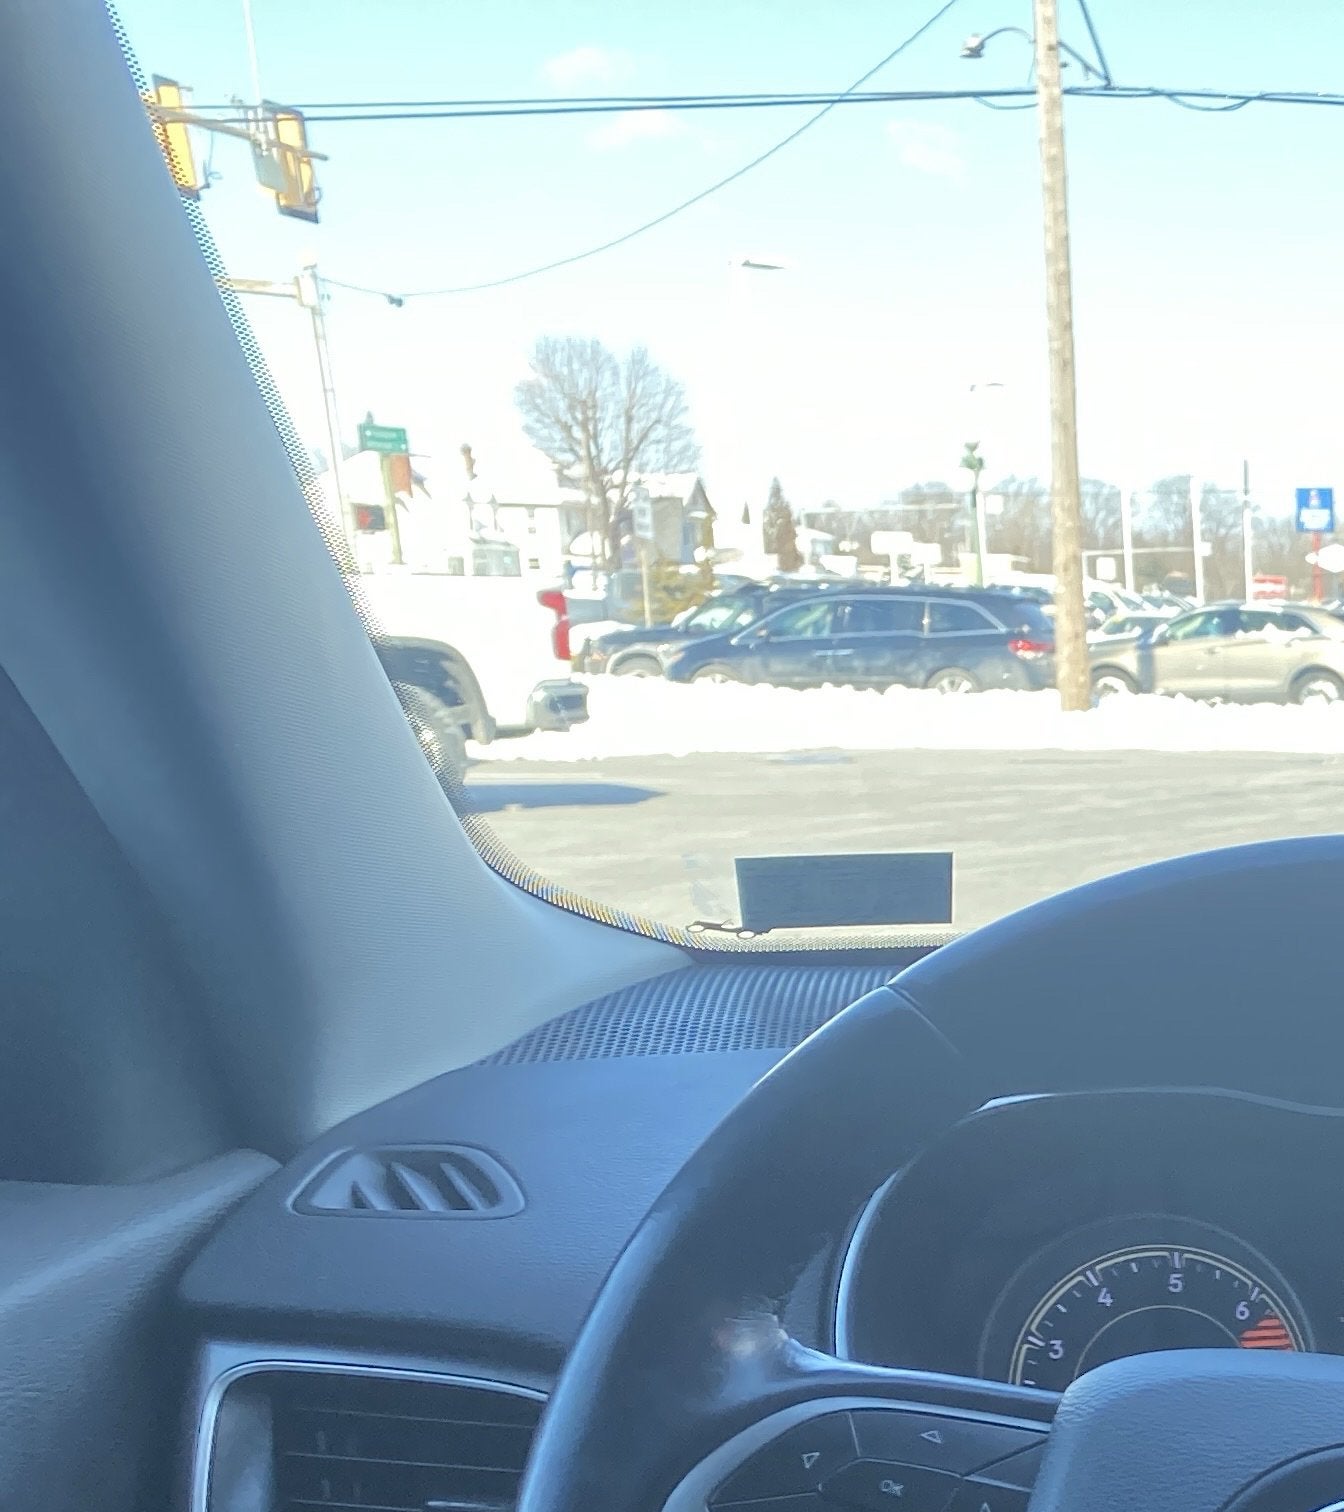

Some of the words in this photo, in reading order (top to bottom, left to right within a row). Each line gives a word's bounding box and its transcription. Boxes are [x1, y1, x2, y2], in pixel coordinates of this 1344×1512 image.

[1168, 1273, 1183, 1293] 5
[1097, 1287, 1113, 1306] 4
[1235, 1301, 1250, 1320] 6
[1049, 1340, 1064, 1359] 3
